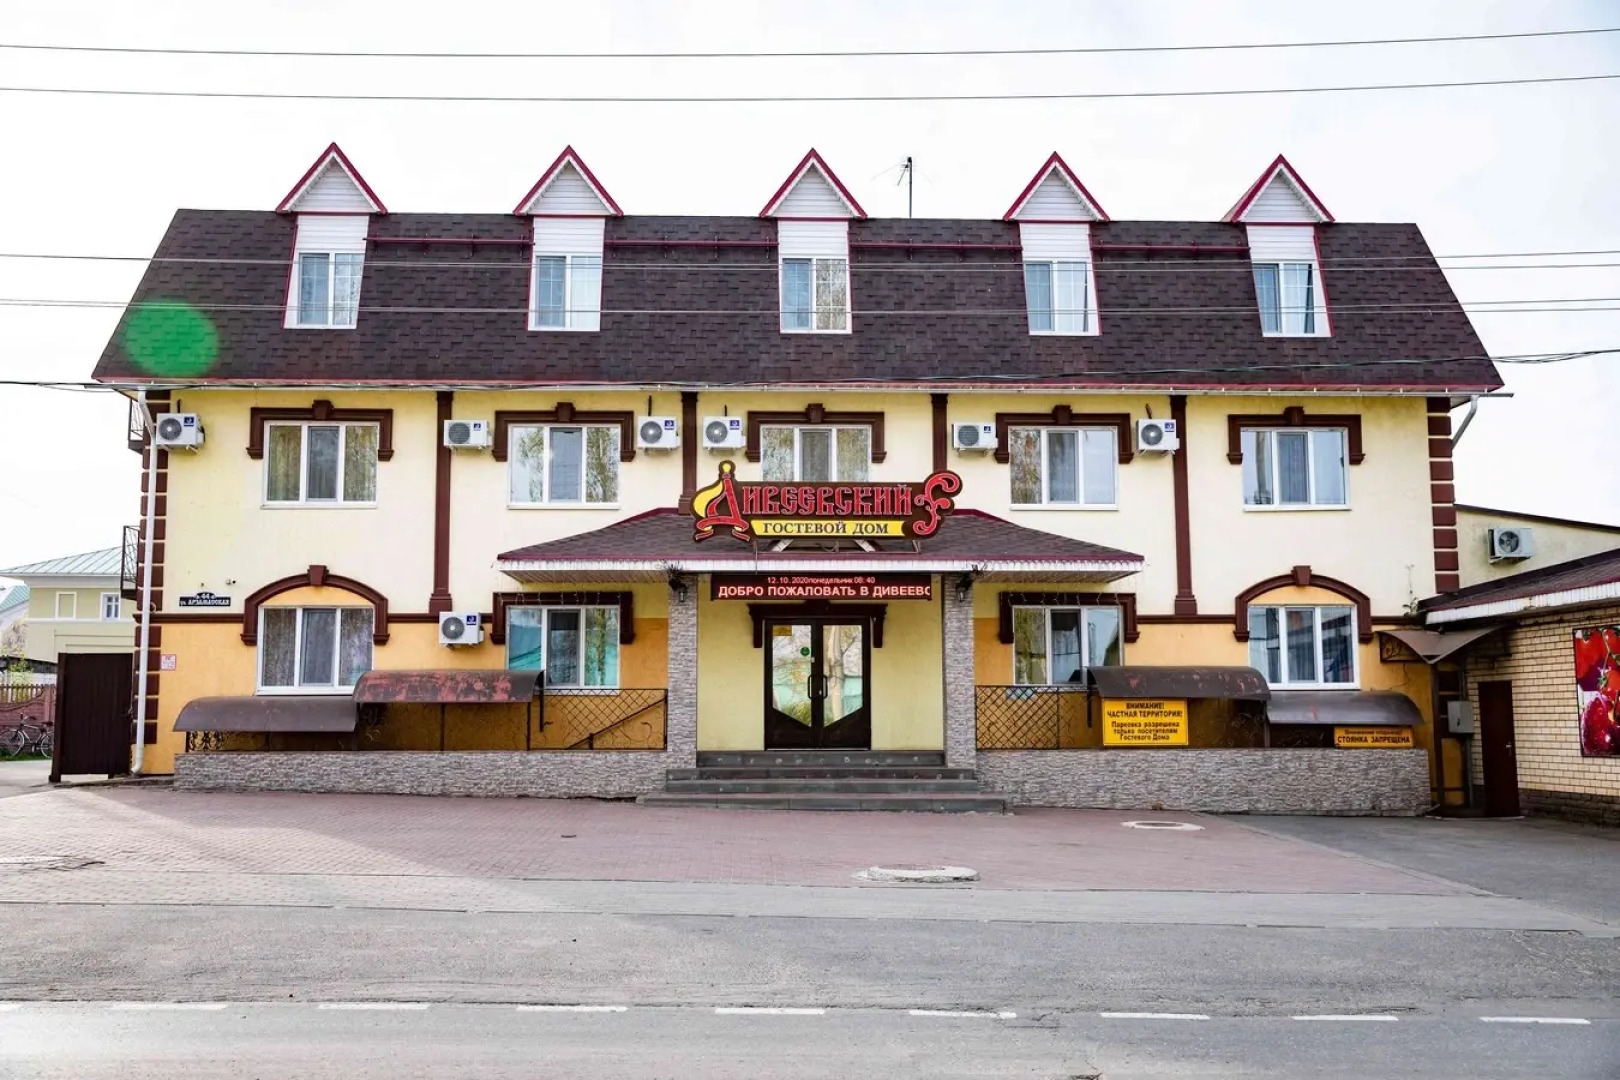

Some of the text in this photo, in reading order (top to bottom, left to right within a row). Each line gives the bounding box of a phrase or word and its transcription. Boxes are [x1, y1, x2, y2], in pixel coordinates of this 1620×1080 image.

[763, 521, 889, 535] ГОСТЕВОЙ ДОМ
[718, 586, 764, 598] ДОБРО
[767, 586, 857, 596] ПОЖАЛОВАТЬ
[860, 586, 869, 596] В
[1126, 702, 1165, 710] ВНИМАНИЕ!
[1107, 710, 1183, 718] ЧАСТНАЯ ТЕРРИТОРИЯ!
[1111, 721, 1142, 729] Парковка
[1371, 736, 1411, 744] ЗАПРЕЩЕНА
